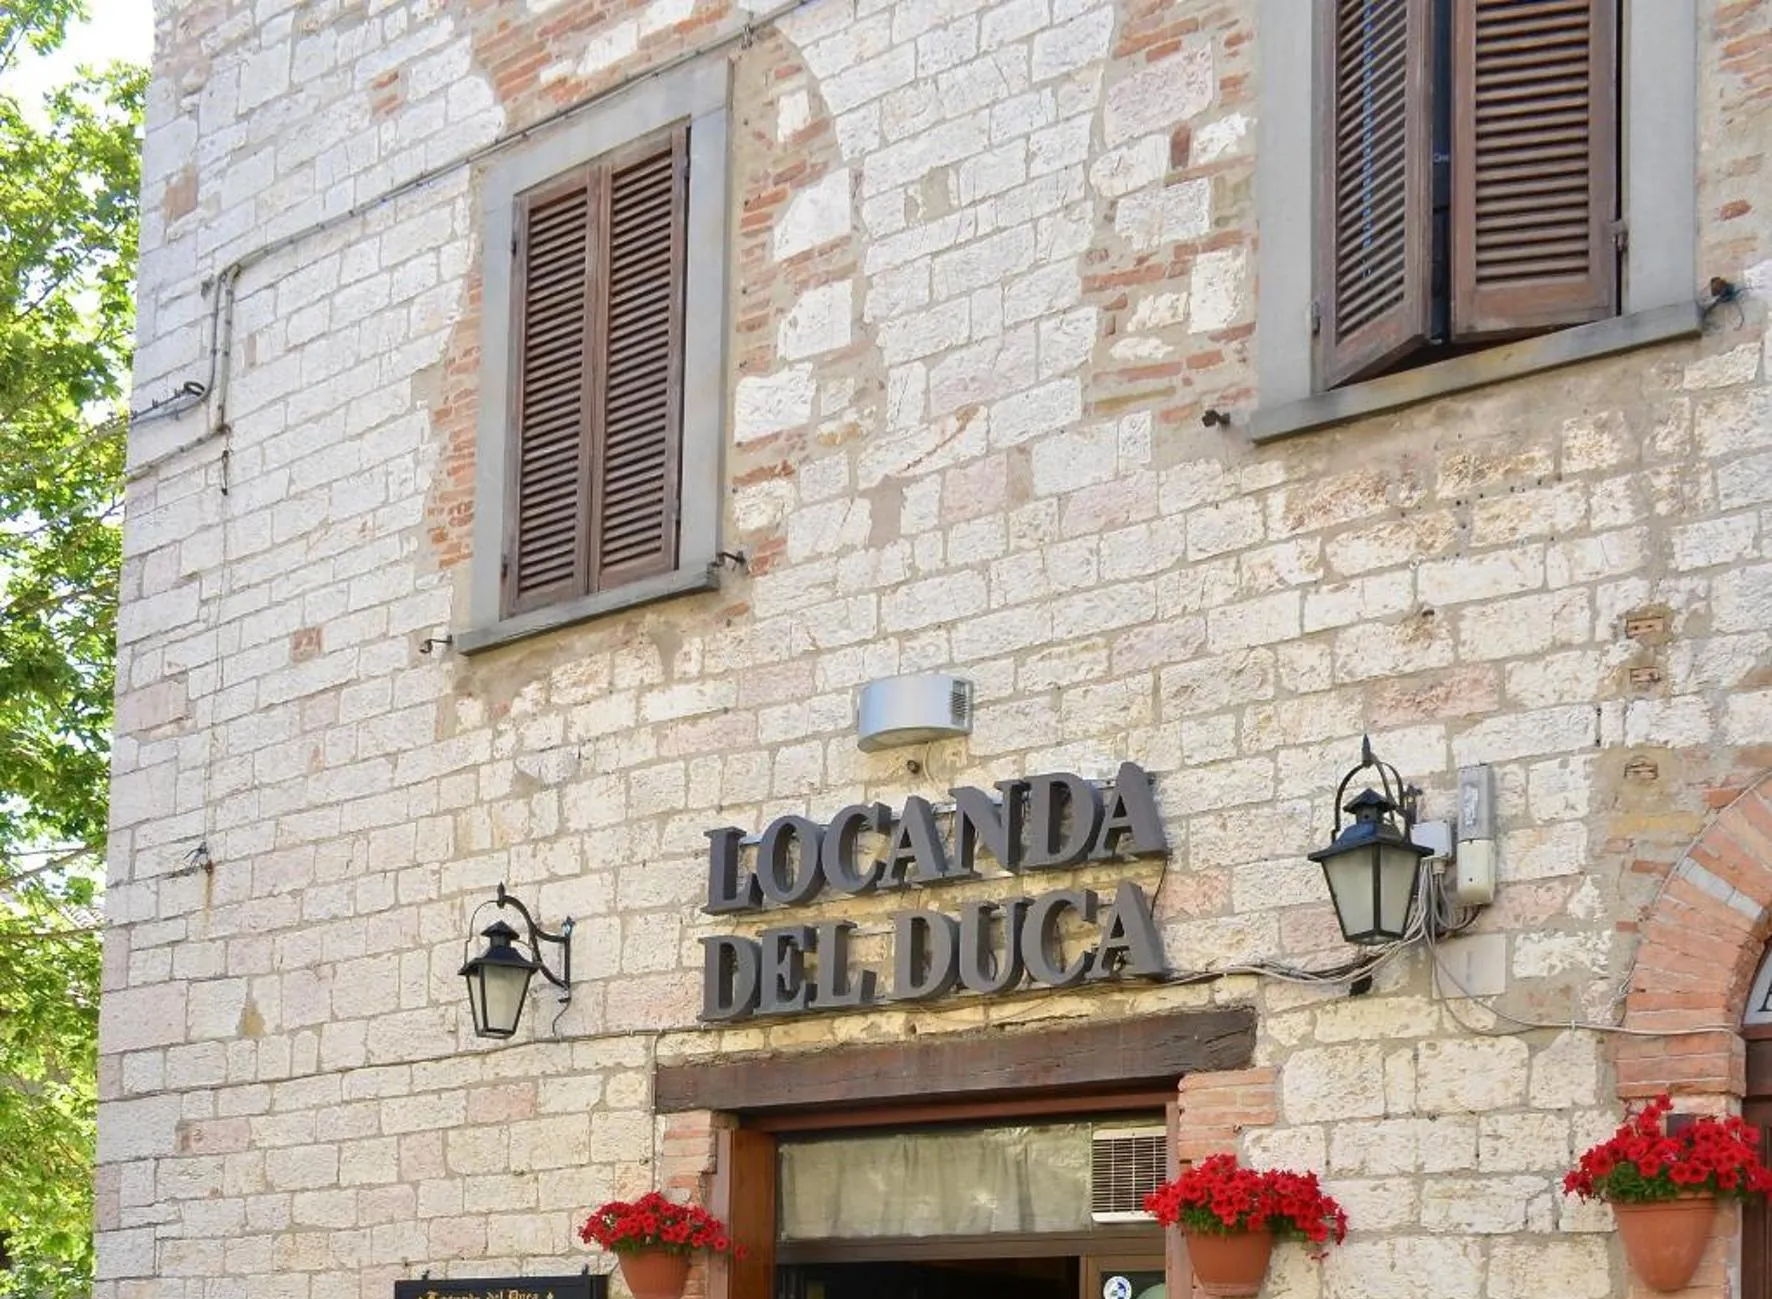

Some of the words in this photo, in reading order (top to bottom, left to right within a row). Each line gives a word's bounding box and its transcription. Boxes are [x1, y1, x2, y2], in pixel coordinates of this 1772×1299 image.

[703, 761, 1170, 915] LOCANDA
[700, 920, 879, 1023] DEL
[893, 880, 1169, 1001] DUCA
